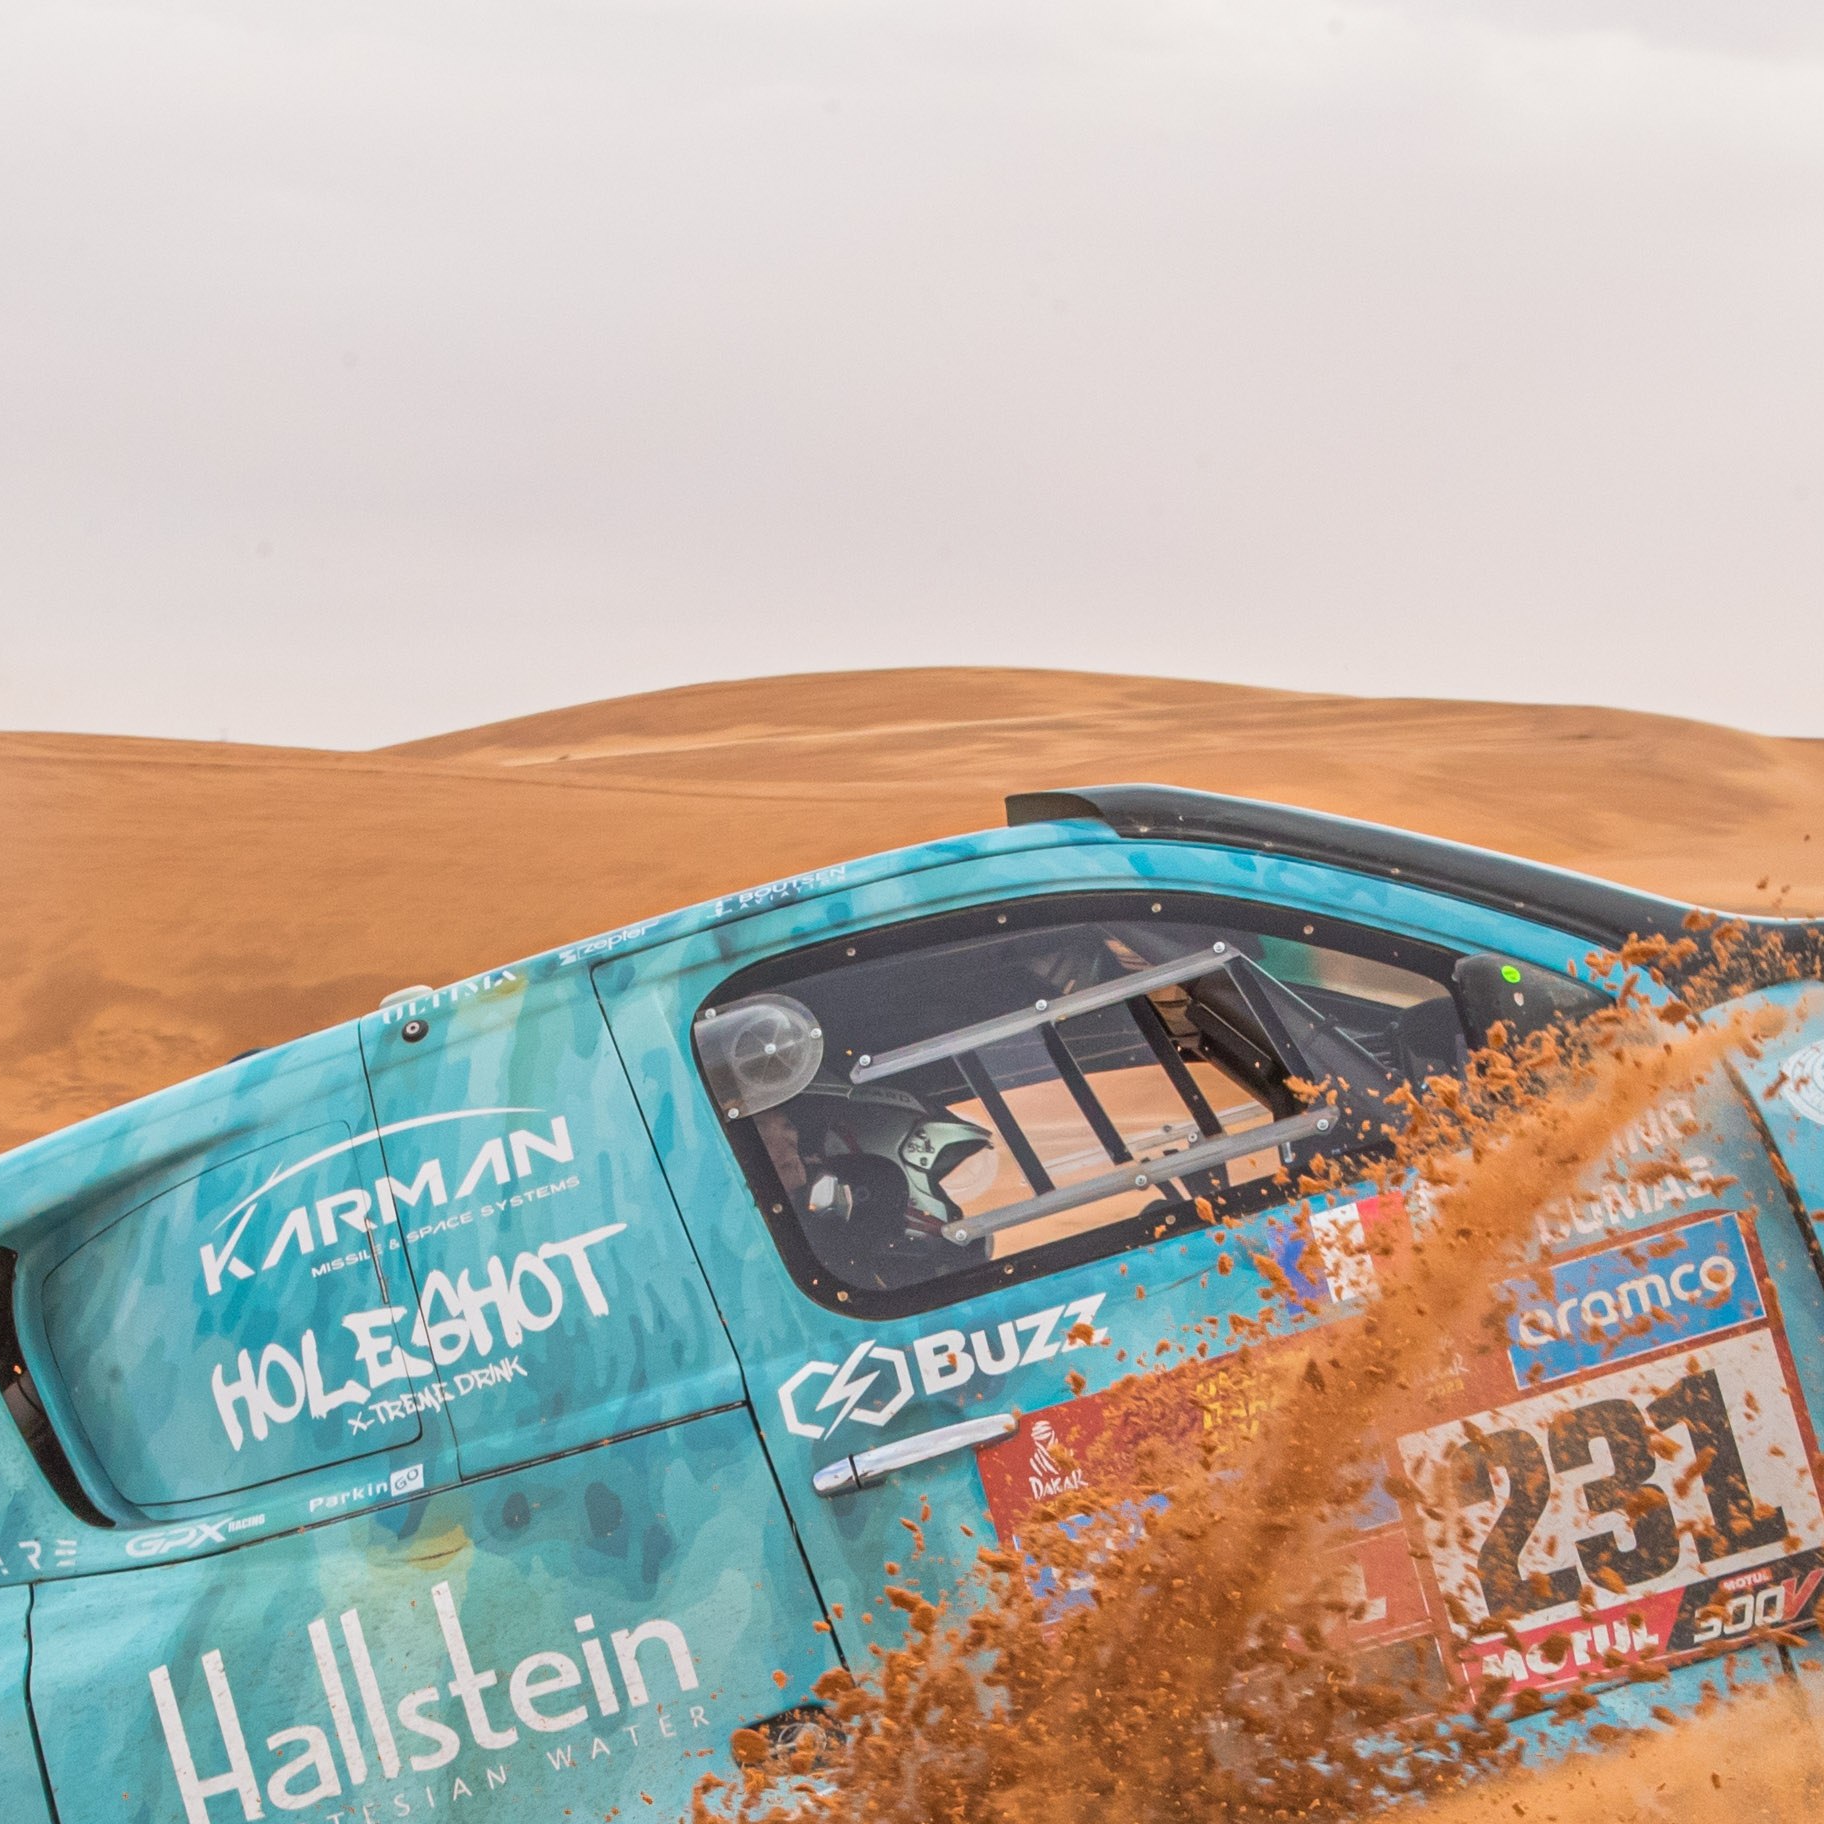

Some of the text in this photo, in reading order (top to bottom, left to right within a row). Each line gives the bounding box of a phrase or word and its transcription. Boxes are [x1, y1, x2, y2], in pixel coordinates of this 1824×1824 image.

[739, 865, 846, 904] BOUTSEN
[199, 1115, 576, 1297] KARMAN
[406, 1210, 473, 1245] SPACE
[479, 1175, 581, 1218] SYSTEMS
[1518, 1254, 1737, 1346] aramco
[210, 1222, 628, 1452] HOLESHOT
[913, 1292, 1109, 1396] BUZZ
[453, 1354, 528, 1397] DRINK
[1028, 1468, 1089, 1501] DAKAR
[1448, 1368, 1790, 1618] 231
[125, 1512, 266, 1558] GPX RACING
[1482, 1620, 1660, 1683] MOTUL
[547, 1704, 710, 1771] WATER
